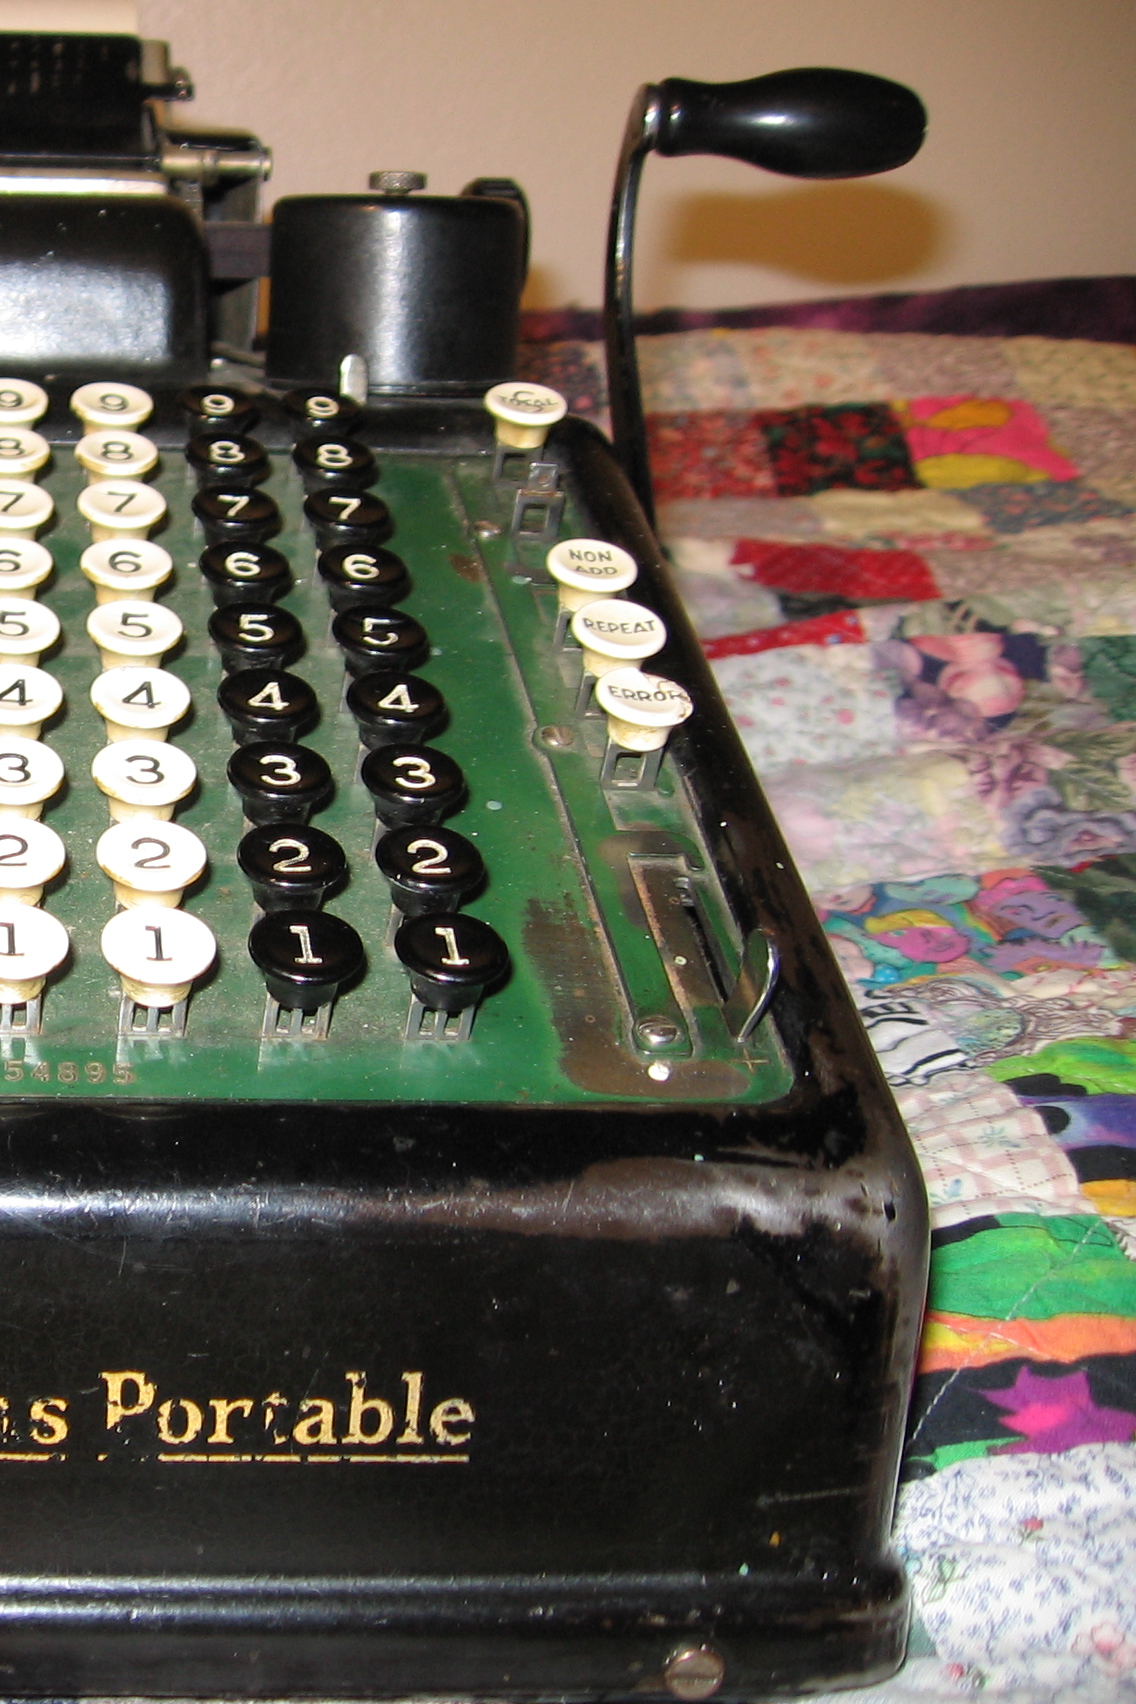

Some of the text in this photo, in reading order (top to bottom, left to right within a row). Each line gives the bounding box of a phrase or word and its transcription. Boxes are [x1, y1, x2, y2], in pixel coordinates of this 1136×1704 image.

[98, 393, 129, 413] 9
[202, 394, 235, 416] 9
[306, 396, 339, 419] 9
[97, 441, 135, 462] 8
[210, 440, 246, 464] 8
[317, 443, 353, 469] 8
[107, 491, 137, 514] 7
[218, 494, 250, 517] 7
[329, 496, 361, 520] 7
[107, 550, 143, 574] 6
[225, 551, 261, 577] 6
[343, 553, 380, 579] 6
[568, 548, 613, 562] NON
[575, 565, 618, 575] ADD
[117, 612, 153, 639] 5
[238, 613, 274, 643] 5
[582, 617, 655, 634] REPEAT
[121, 681, 162, 710] 4
[248, 681, 290, 711] 4
[377, 684, 419, 713] 4
[125, 754, 165, 785] 3
[259, 754, 302, 786] 3
[392, 756, 436, 789] 3
[130, 836, 171, 870] 2
[269, 838, 312, 873] 2
[407, 839, 452, 874] 2
[144, 925, 173, 962] 1
[289, 925, 323, 964] 1
[434, 926, 470, 966] 1
[98, 1369, 476, 1446] Portable
